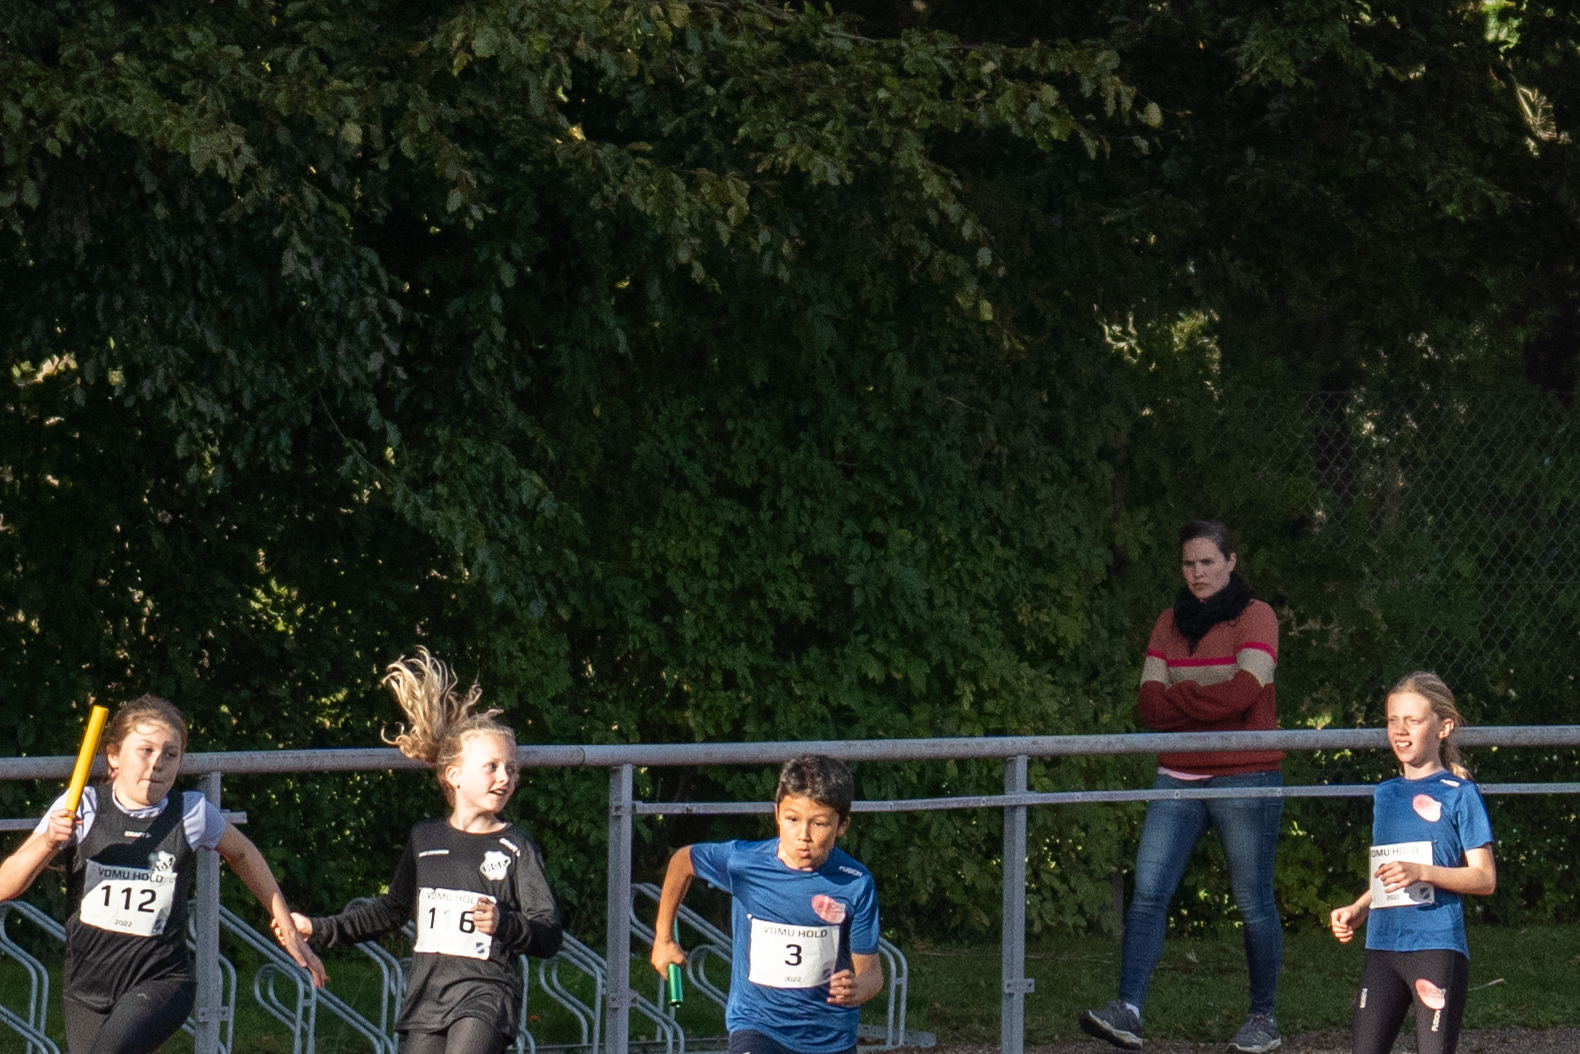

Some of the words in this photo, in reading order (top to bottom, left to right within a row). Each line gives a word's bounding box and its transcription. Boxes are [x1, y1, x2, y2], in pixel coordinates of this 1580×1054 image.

[1370, 848, 1390, 858] DMU
[98, 867, 130, 880] VDMU
[133, 872, 163, 883] HOLD
[101, 884, 156, 913] 112
[764, 926, 795, 937] VDMU
[798, 929, 828, 938] HOLD
[785, 944, 802, 966] 3
